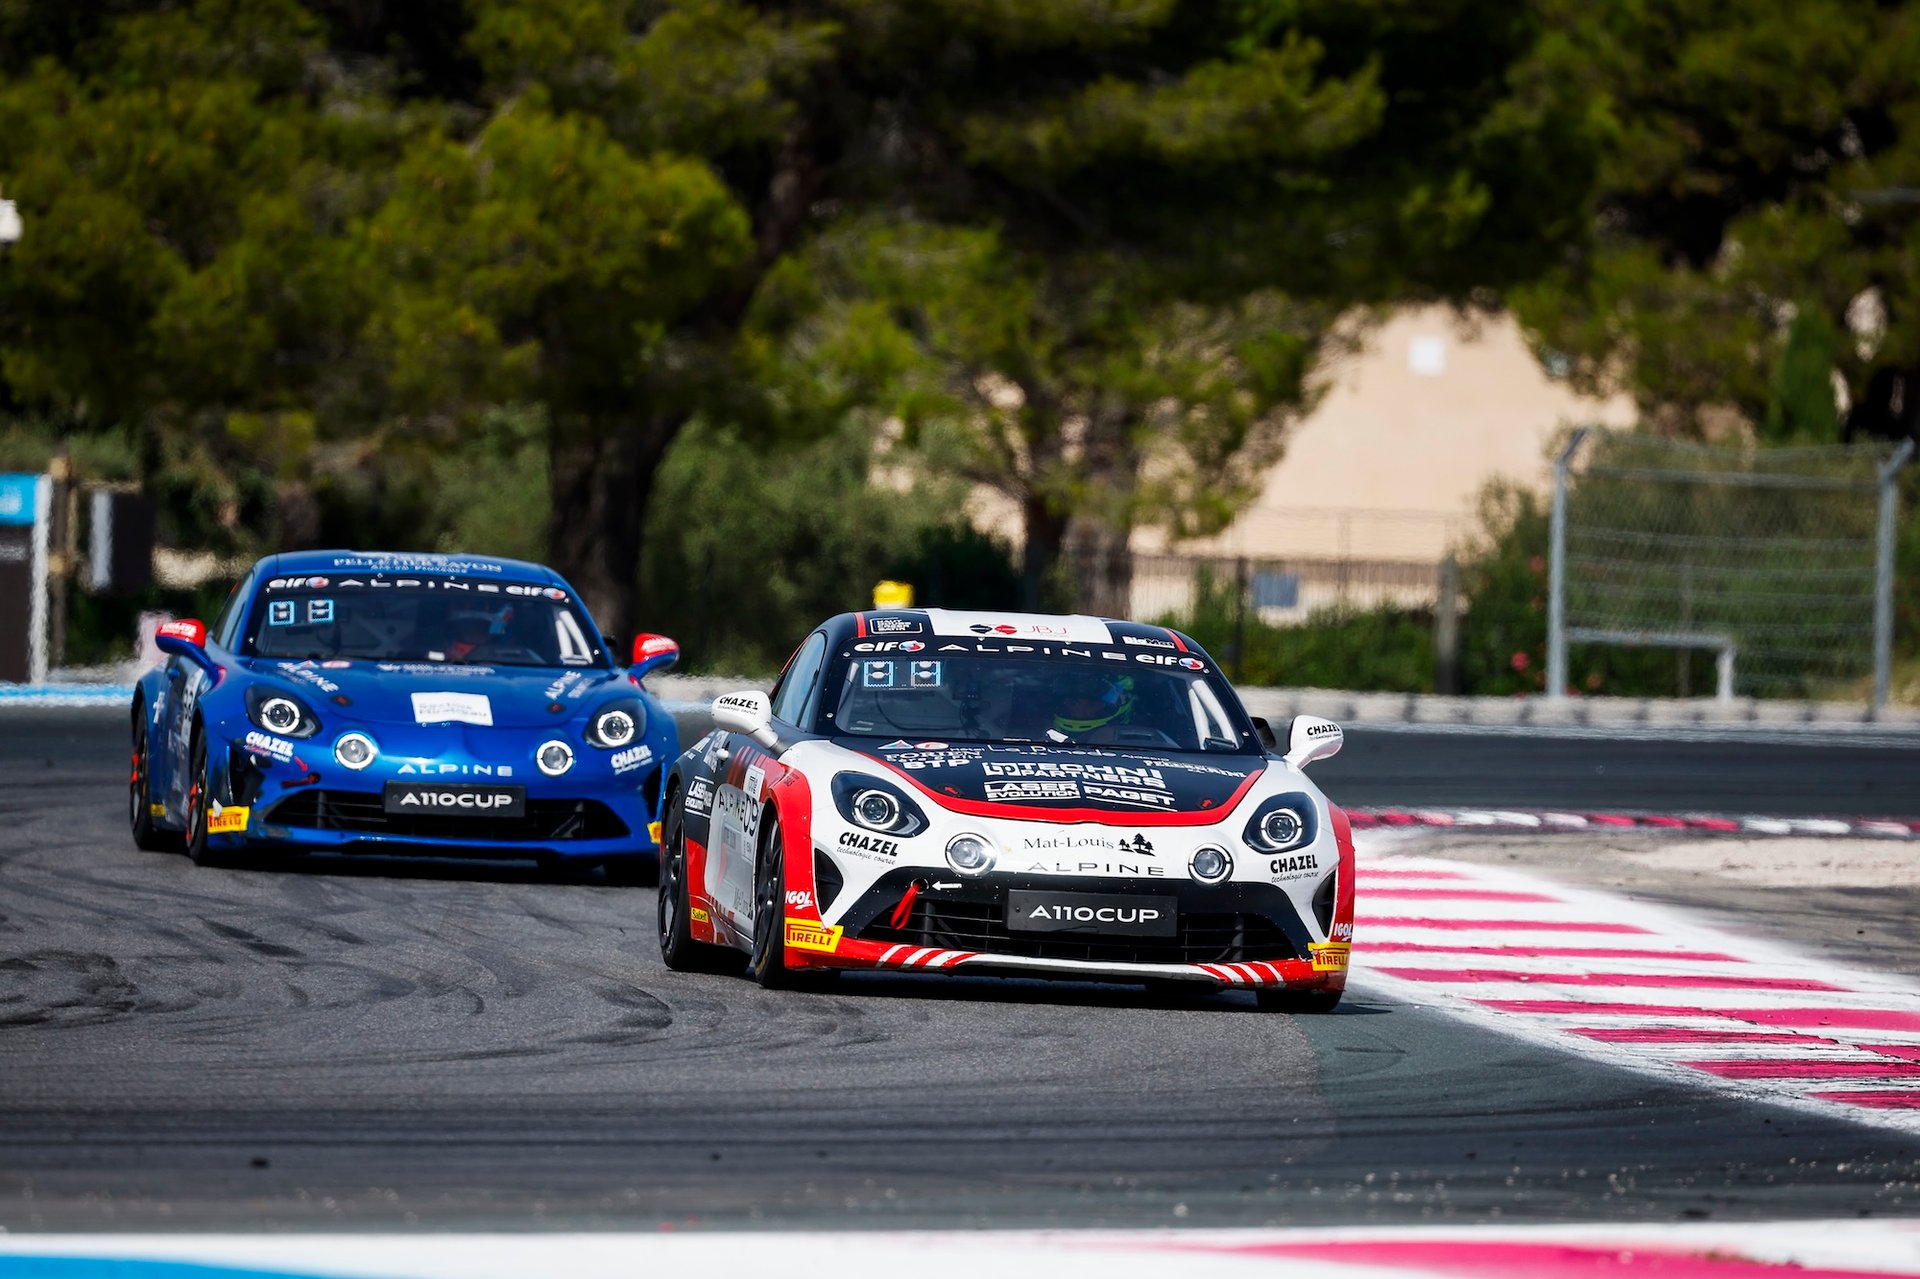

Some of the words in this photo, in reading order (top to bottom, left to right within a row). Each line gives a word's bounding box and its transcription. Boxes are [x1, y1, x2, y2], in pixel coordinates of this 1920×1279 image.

[269, 578, 308, 588] elf
[338, 578, 500, 593] ALPINE
[506, 585, 544, 596] elf
[854, 641, 899, 652] elf
[938, 643, 1127, 661] ALPINE
[1135, 654, 1178, 666] elf
[245, 731, 294, 757] CHAZEL
[610, 744, 652, 768] CHAZEL
[397, 763, 512, 777] ALPINE
[902, 759, 970, 769] BTP
[1018, 762, 1163, 780] TECHNI
[1019, 769, 1166, 789] PARTNERS
[985, 783, 1078, 794] LASER
[986, 790, 1081, 799] EVOLUTION
[1083, 785, 1175, 806] PAGET
[400, 792, 512, 809] A110CUP
[839, 831, 898, 857] CHAZEL
[1024, 837, 1114, 850] Mat-Louis
[1028, 862, 1164, 876] ALPINE
[1270, 854, 1318, 874] CHAZEL
[785, 890, 811, 905] IGOL
[1029, 905, 1159, 923] A110CUP
[786, 923, 835, 946] PIRELLI
[1333, 922, 1353, 937] IGOL
